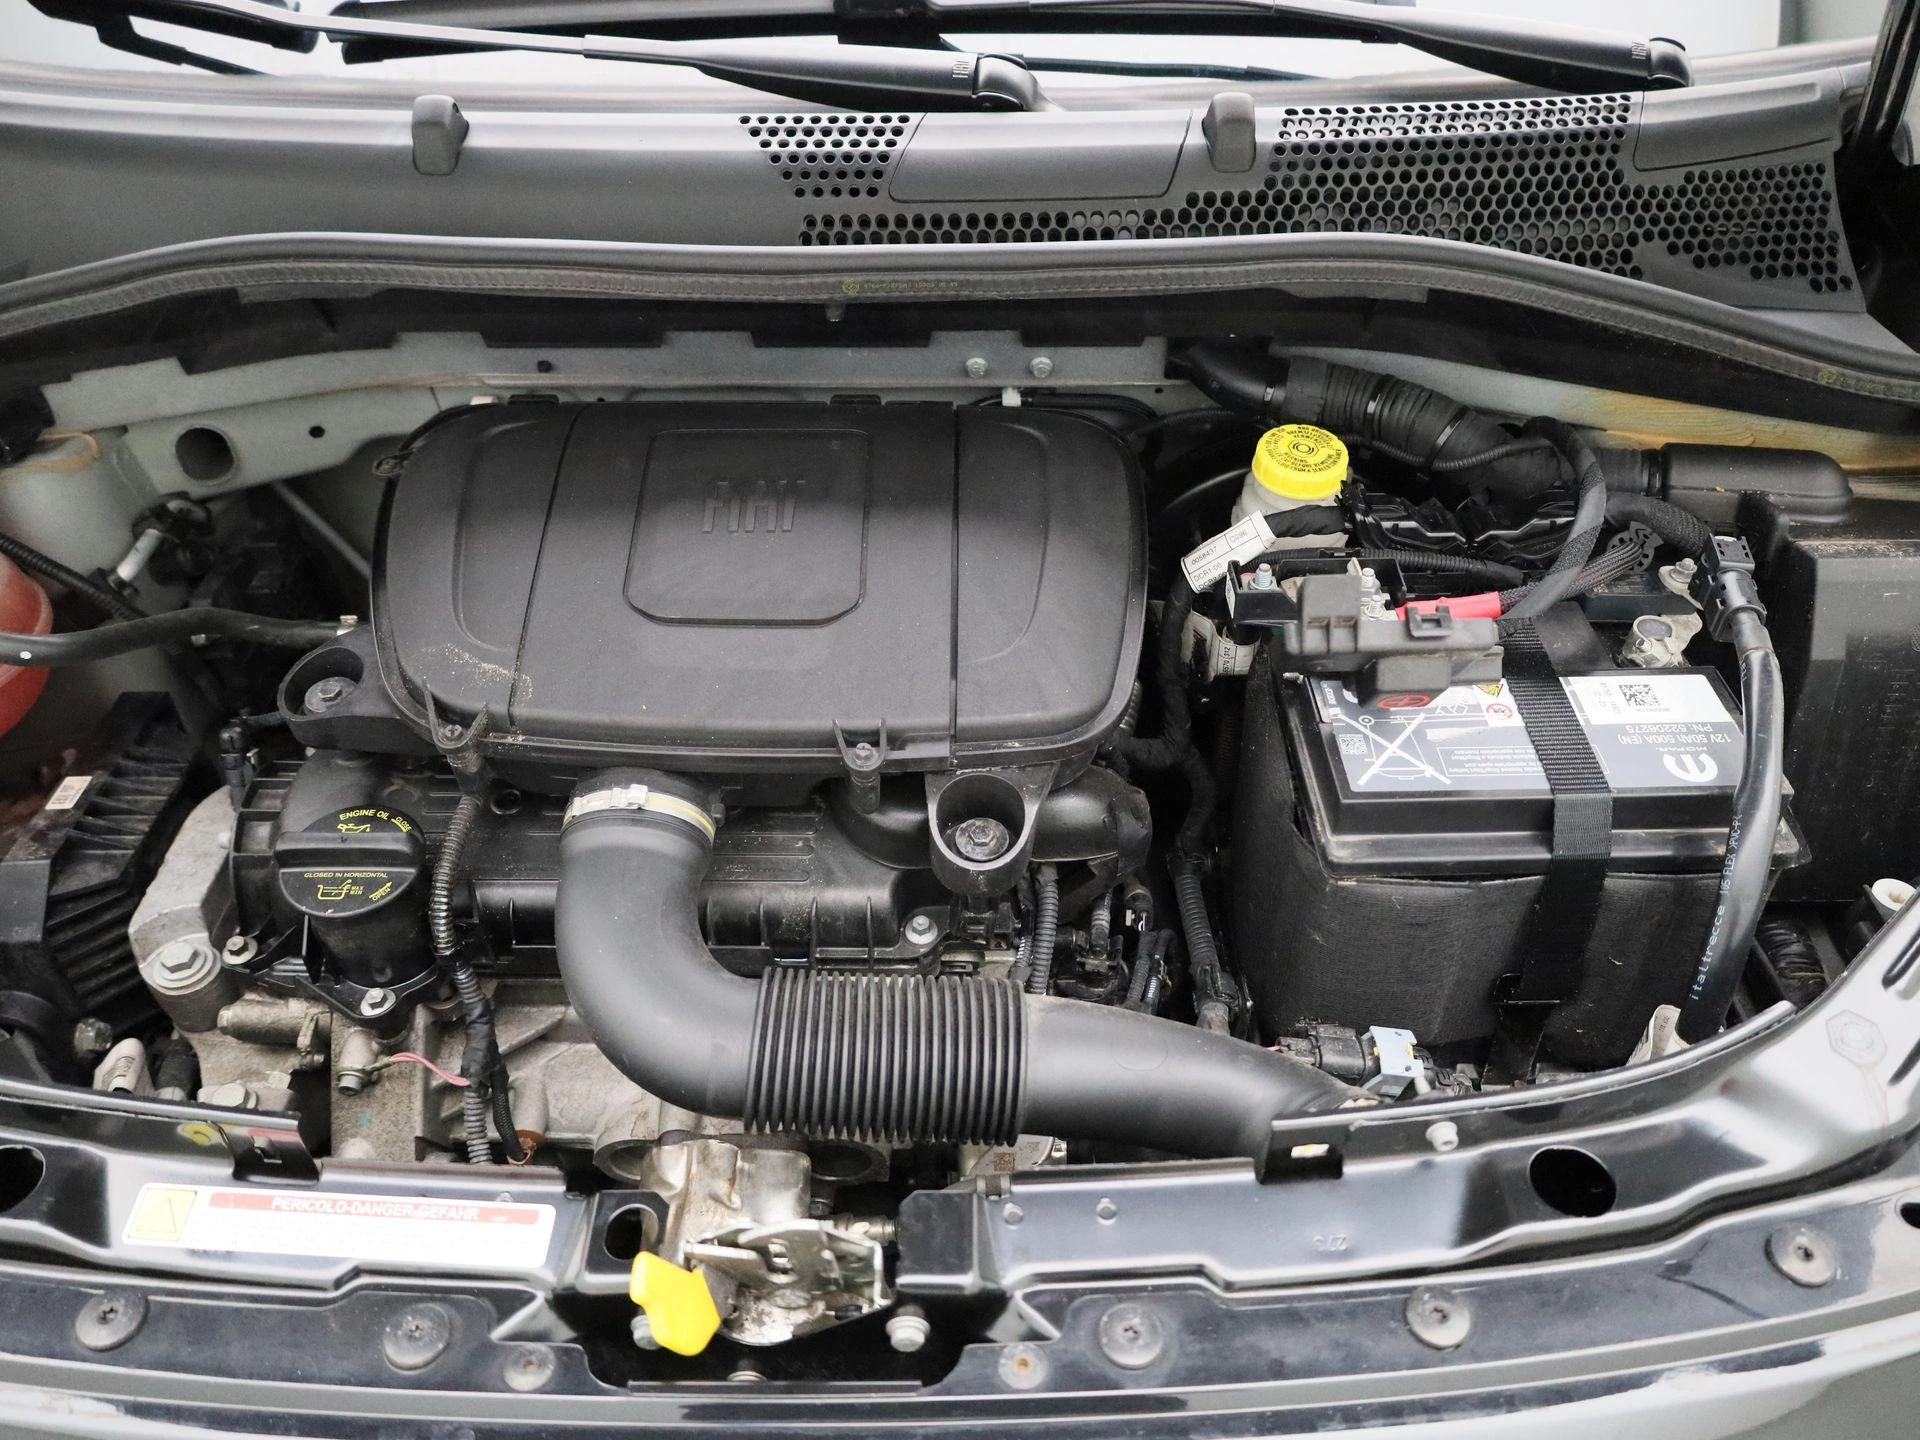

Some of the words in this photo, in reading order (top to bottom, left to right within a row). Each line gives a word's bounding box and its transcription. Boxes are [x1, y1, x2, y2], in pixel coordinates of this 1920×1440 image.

[1617, 733, 1643, 745] (EN)
[1645, 734, 1674, 744] 500A
[1676, 734, 1708, 743] 50Ah
[1709, 733, 1732, 744] 12V
[339, 809, 376, 820] ENGINE
[377, 810, 389, 821] OIL
[395, 816, 412, 832] CLOSE
[372, 887, 391, 901] OPEN
[1689, 905, 1726, 1000] italtrecce
[1723, 853, 1736, 876] FLEX
